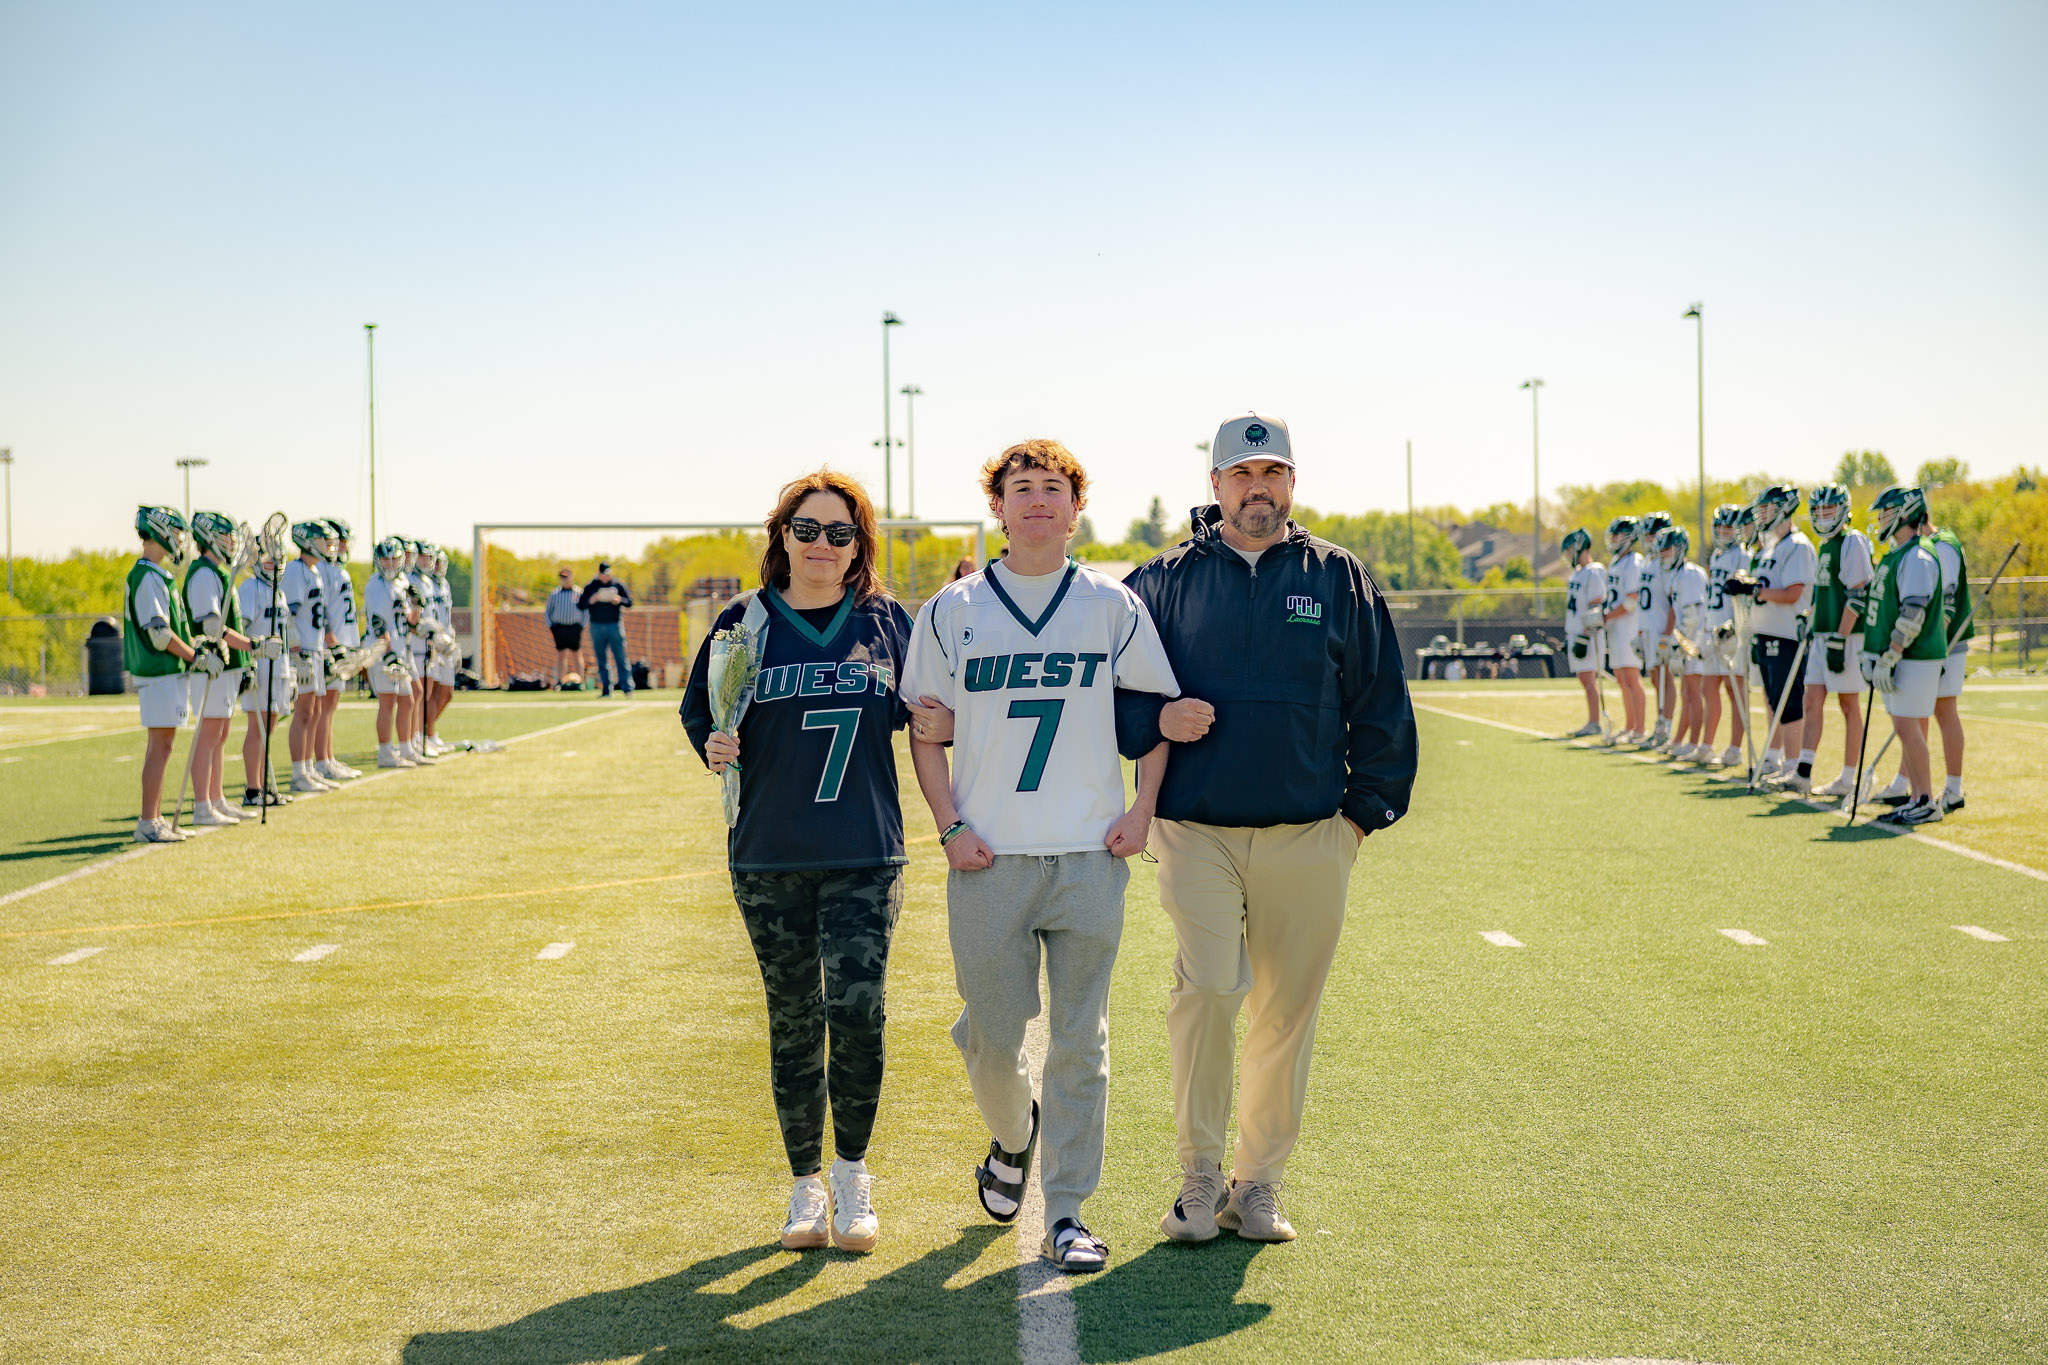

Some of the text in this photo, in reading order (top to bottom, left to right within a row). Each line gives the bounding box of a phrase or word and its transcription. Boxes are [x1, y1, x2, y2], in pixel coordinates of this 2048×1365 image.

[754, 662, 893, 703] WEST
[964, 652, 1109, 692] WEST
[802, 707, 863, 803] 7
[1007, 698, 1066, 792] 7
